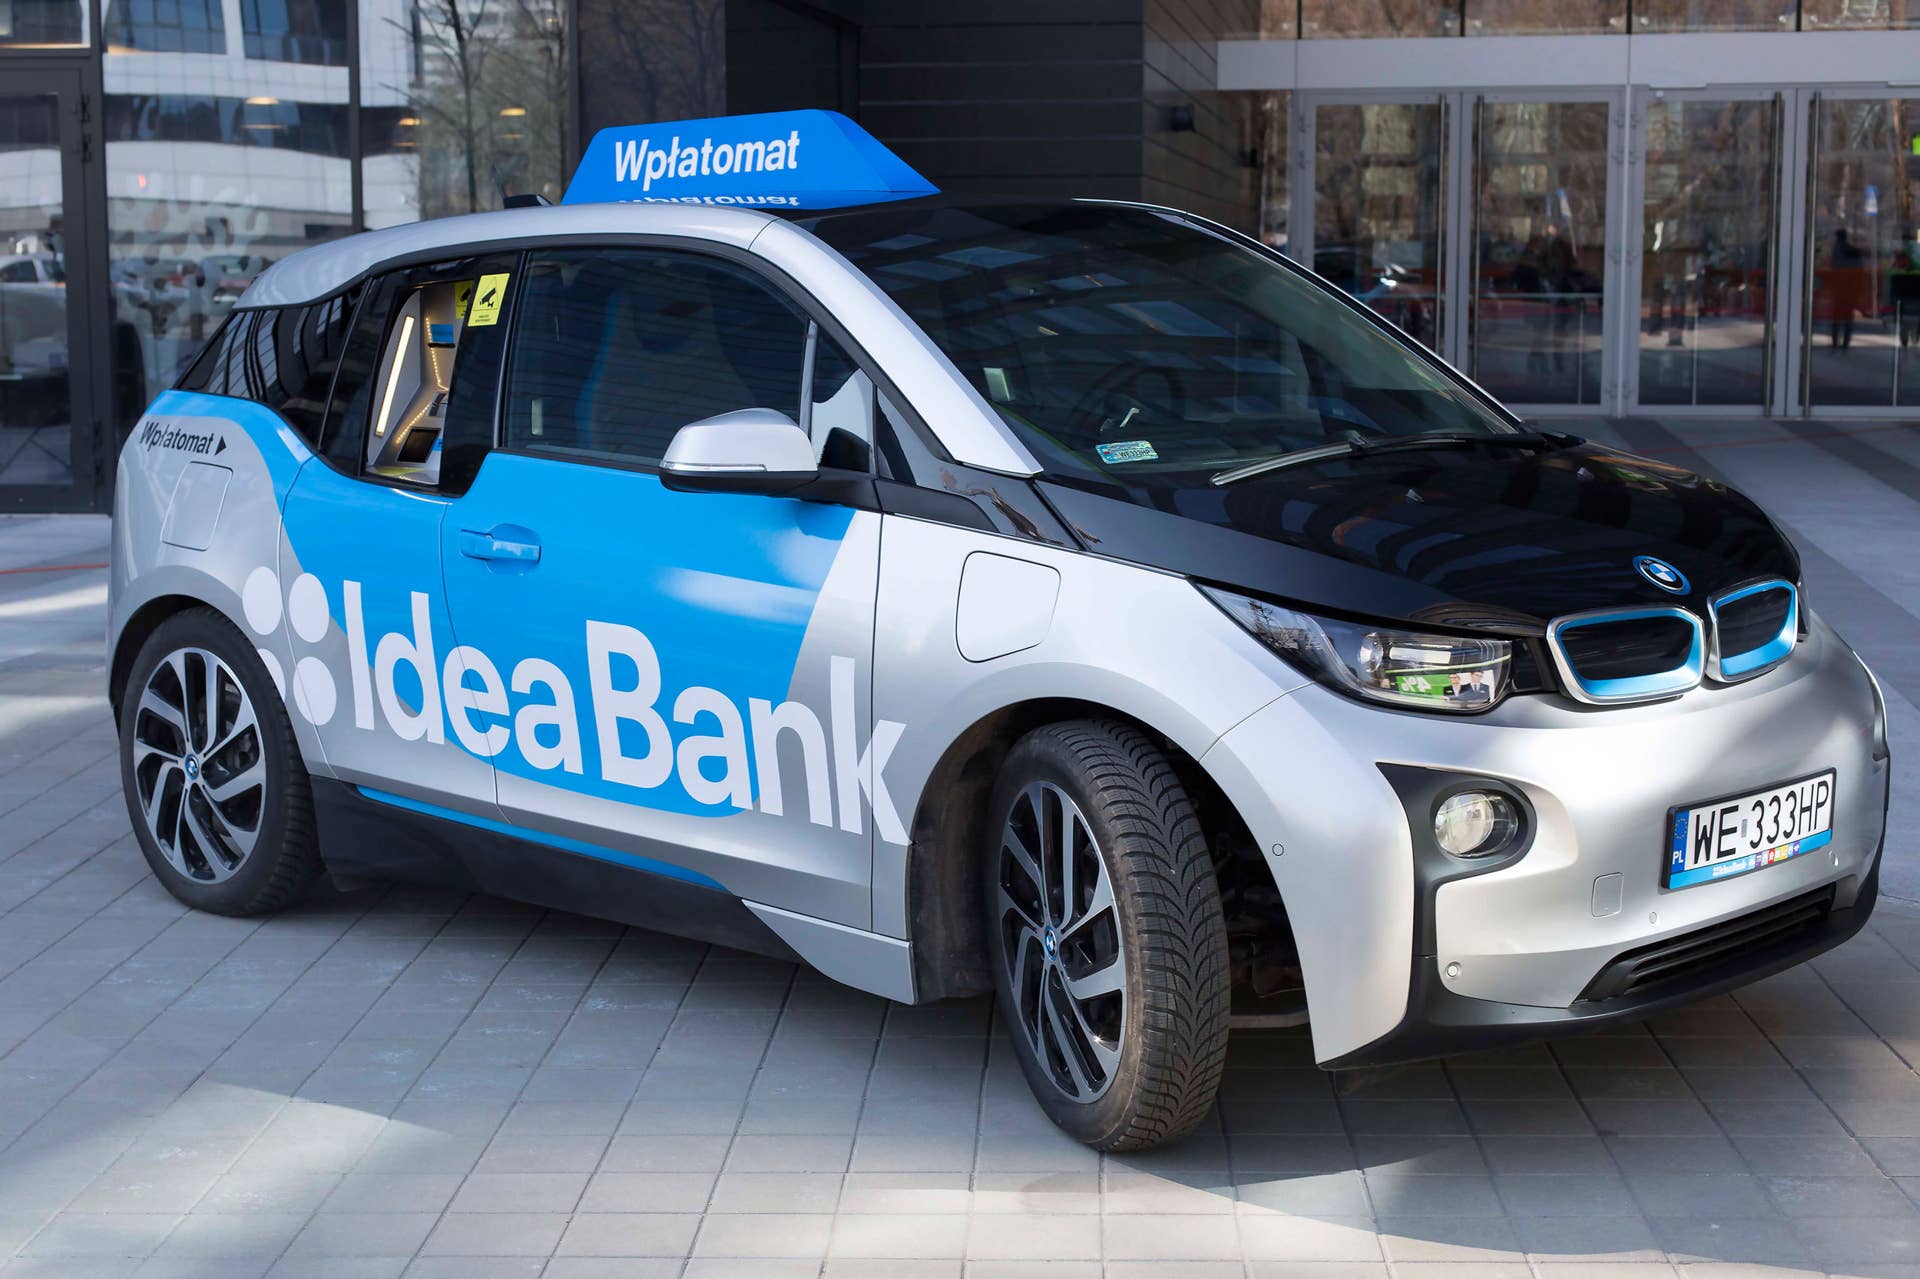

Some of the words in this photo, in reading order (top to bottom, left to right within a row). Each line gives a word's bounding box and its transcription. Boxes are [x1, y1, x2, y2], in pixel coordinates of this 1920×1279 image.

[615, 130, 800, 192] Wpłatomat
[139, 421, 214, 455] Wpłatomat
[1694, 804, 1740, 865] WE
[1750, 780, 1830, 850] 333HP
[1672, 850, 1685, 865] PL
